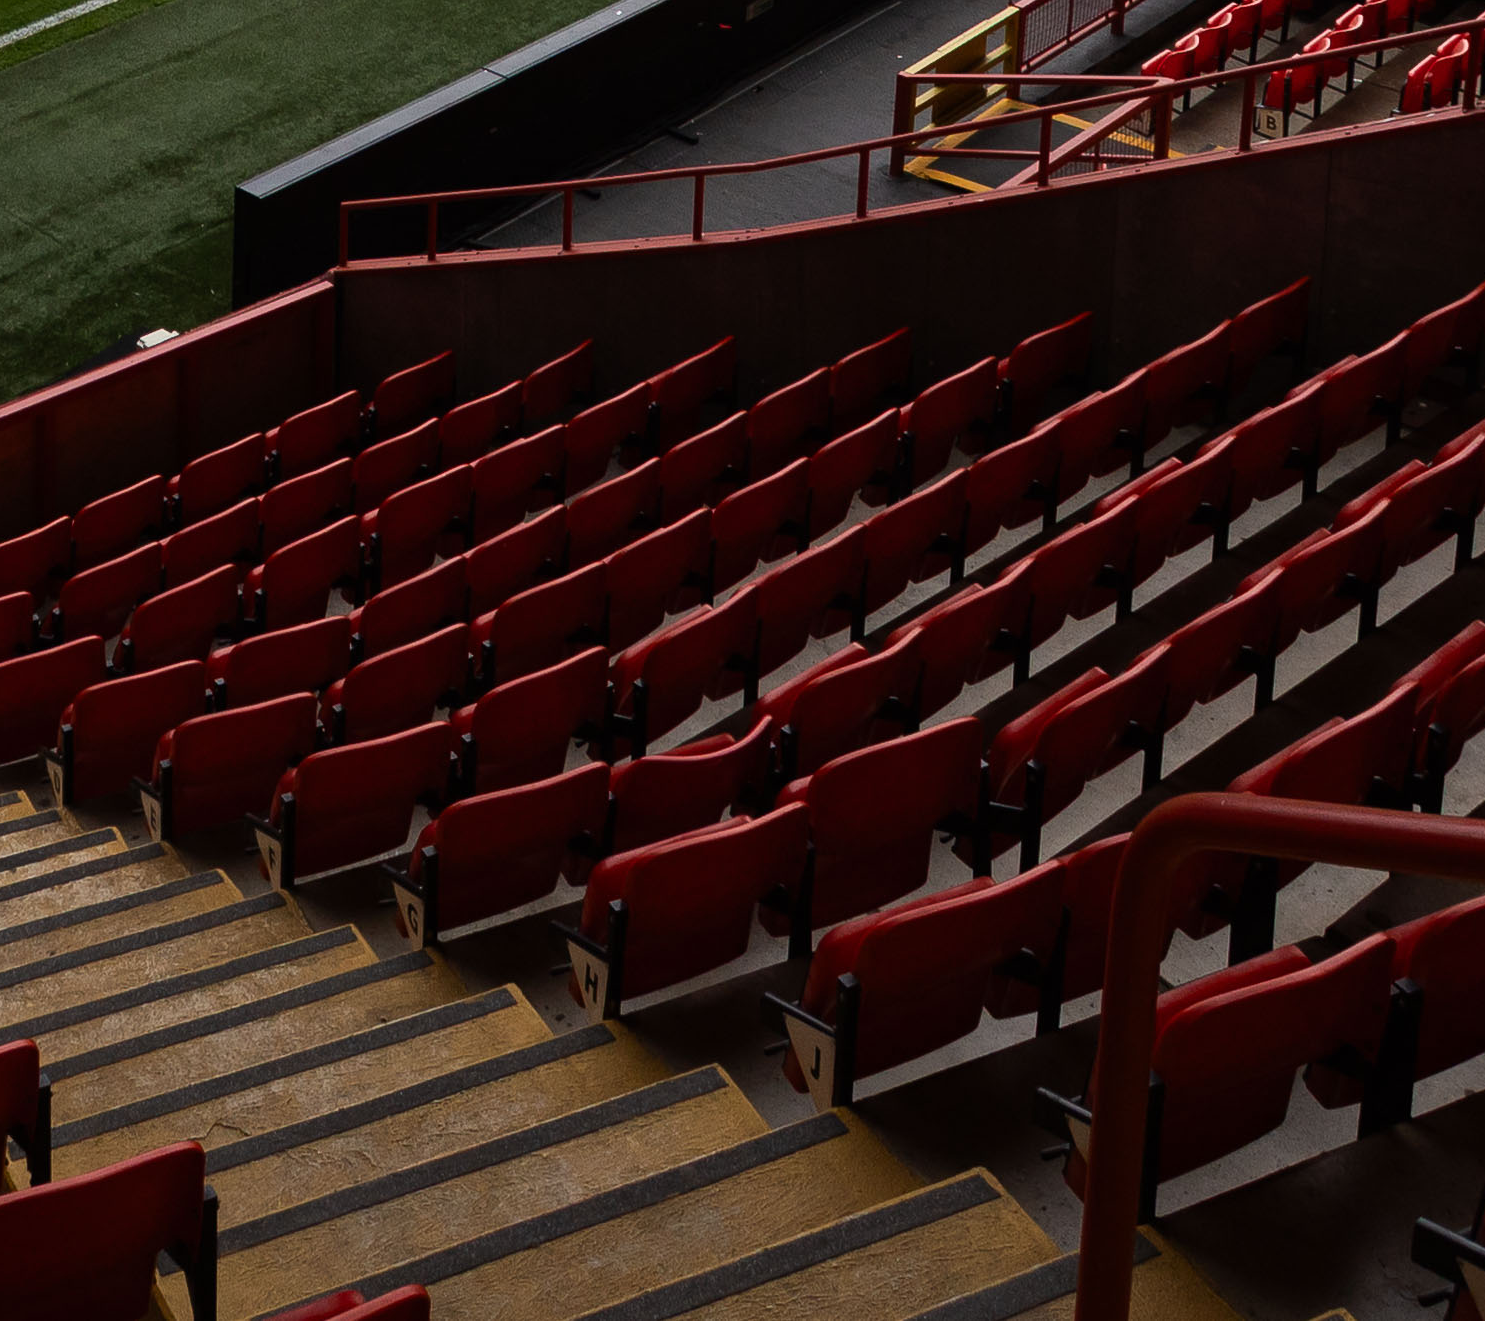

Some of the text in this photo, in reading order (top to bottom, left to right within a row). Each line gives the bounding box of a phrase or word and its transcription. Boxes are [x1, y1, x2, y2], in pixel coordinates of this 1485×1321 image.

[1266, 115, 1277, 130] B
[150, 811, 157, 830] E
[268, 842, 276, 868] F
[407, 902, 418, 938] G
[585, 967, 598, 1002] H
[810, 1045, 821, 1081] J
